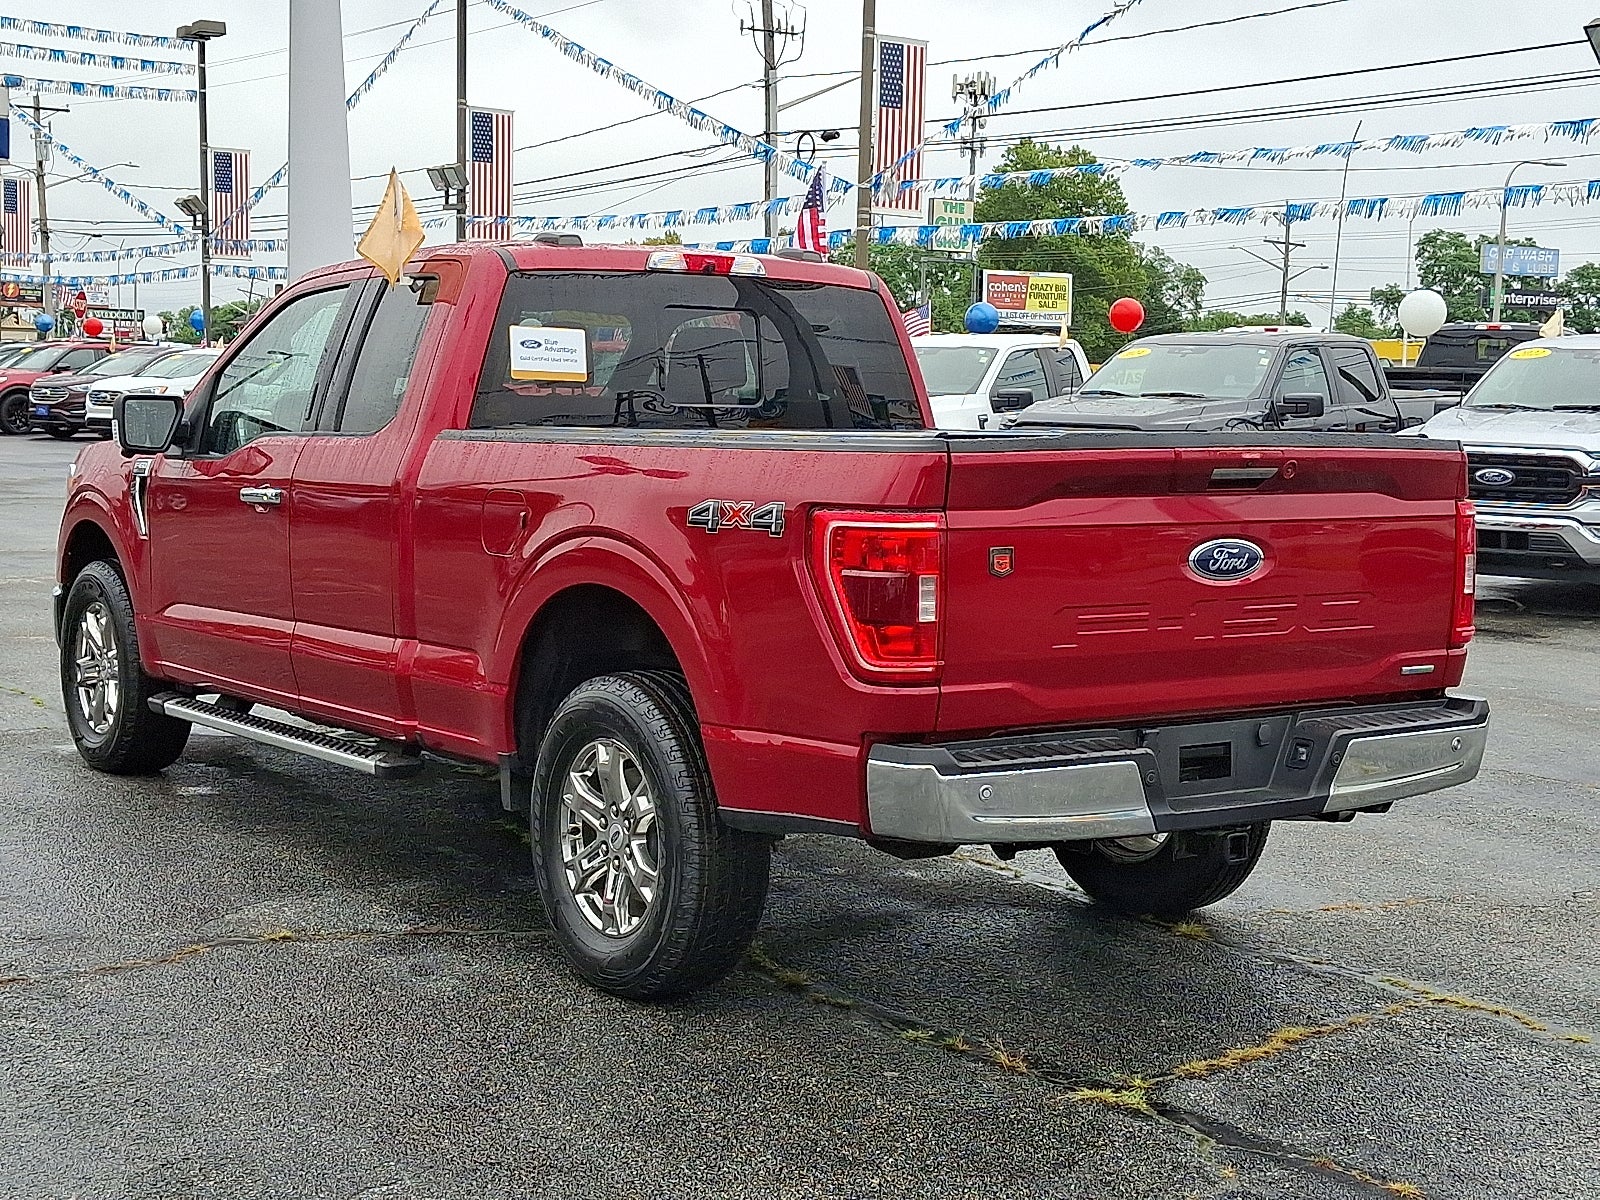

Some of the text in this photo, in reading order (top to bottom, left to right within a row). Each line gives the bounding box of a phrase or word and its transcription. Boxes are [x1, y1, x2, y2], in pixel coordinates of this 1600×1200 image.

[943, 201, 965, 214] THE
[1520, 249, 1554, 262] WASH
[1527, 263, 1555, 273] LUBE
[988, 281, 1027, 292] cohen's
[1029, 283, 1067, 292] CRAZY BIG
[1029, 292, 1067, 301] FURNITURE
[76, 298, 85, 311] STOP
[544, 338, 559, 346] Blue
[544, 346, 577, 355] Advantage
